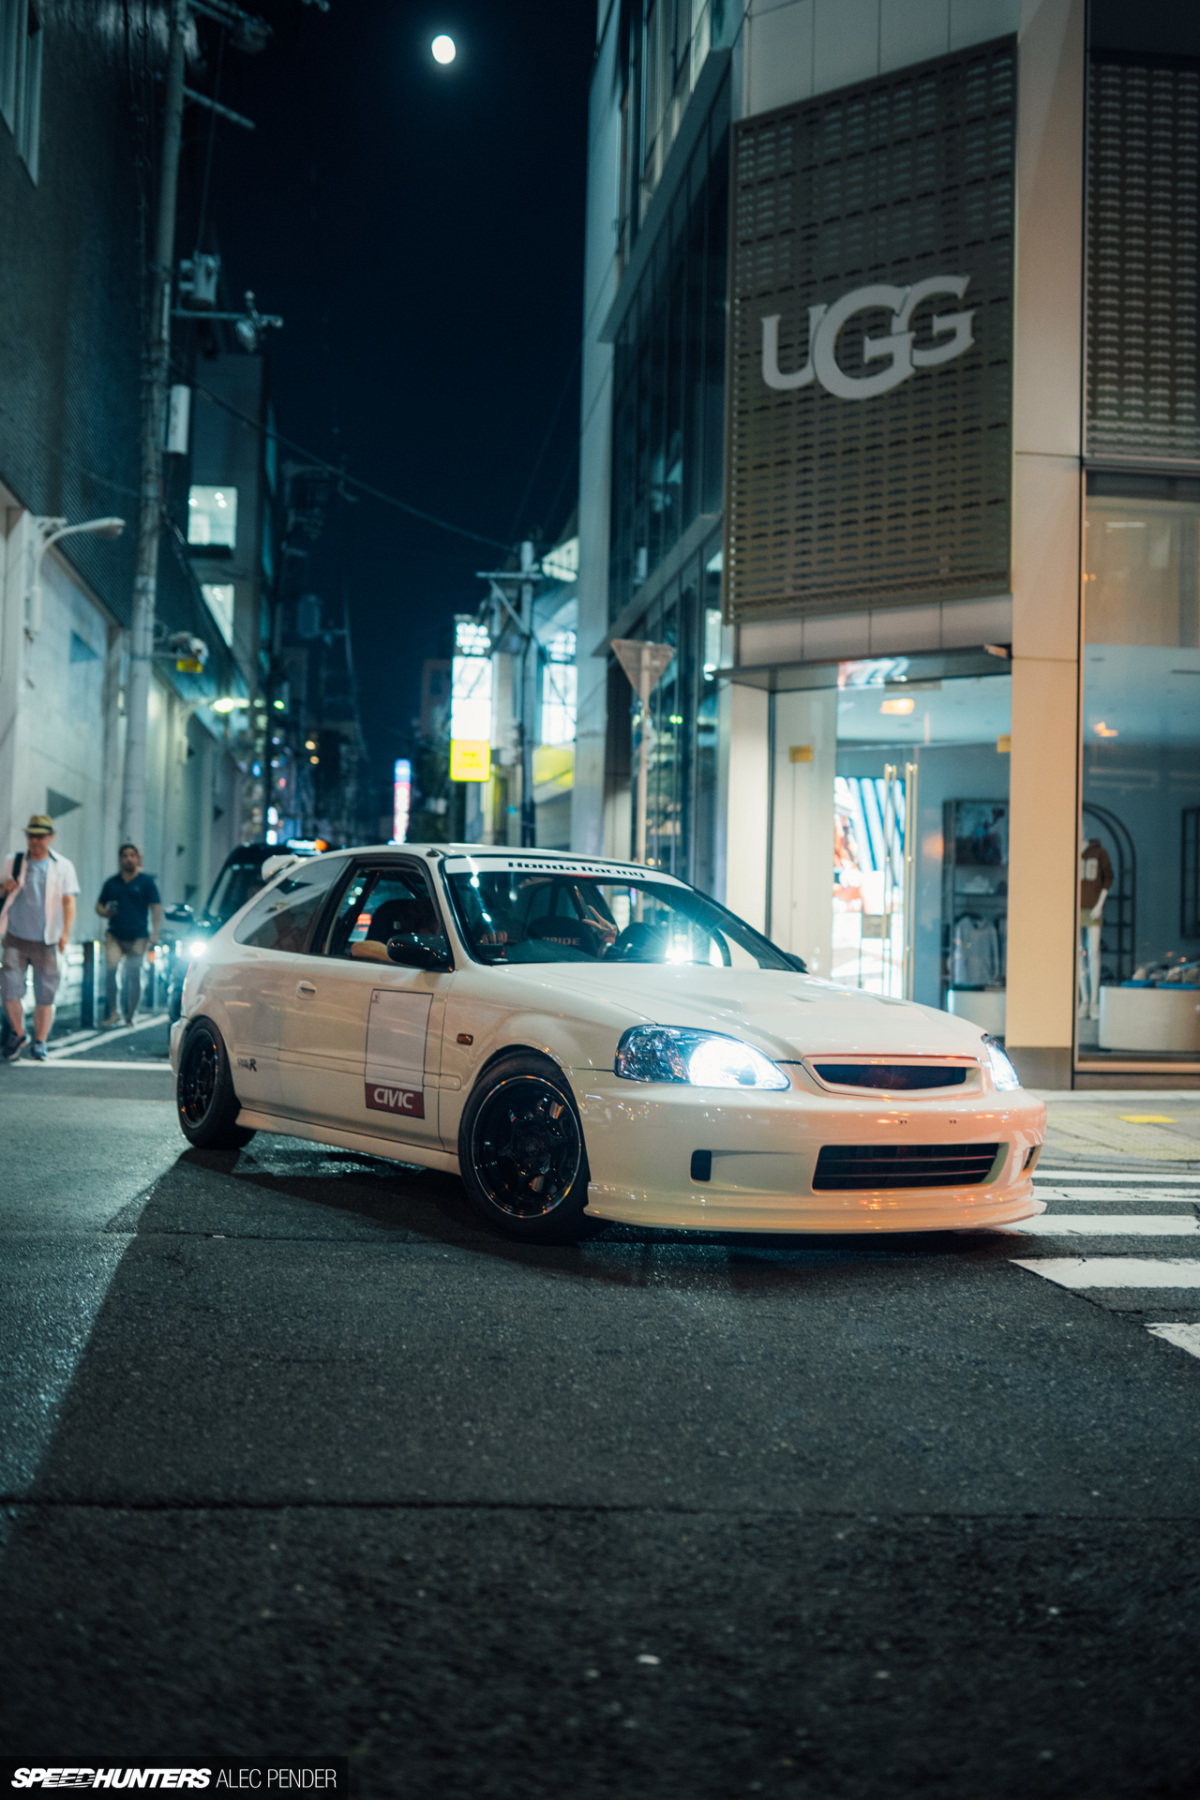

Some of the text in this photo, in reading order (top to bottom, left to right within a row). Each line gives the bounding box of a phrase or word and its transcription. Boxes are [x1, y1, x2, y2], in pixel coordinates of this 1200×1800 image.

[761, 275, 976, 399] UGG
[508, 862, 645, 879] Honda Racing
[373, 1087, 414, 1109] CIVIC
